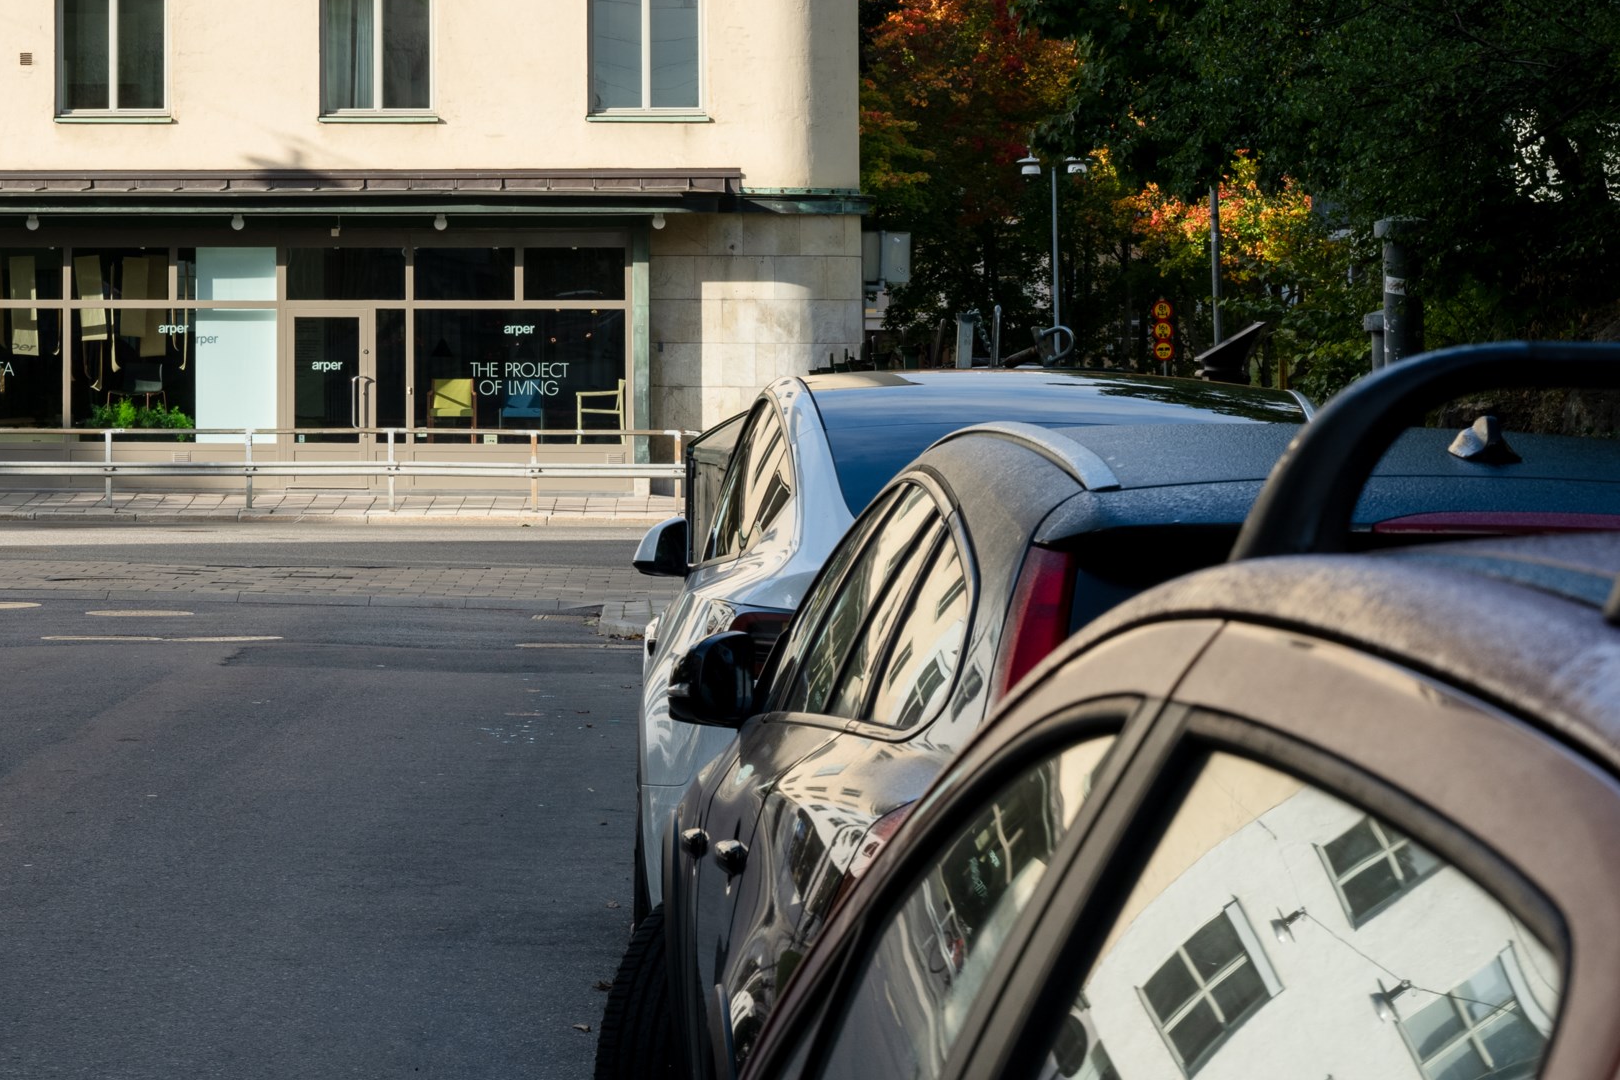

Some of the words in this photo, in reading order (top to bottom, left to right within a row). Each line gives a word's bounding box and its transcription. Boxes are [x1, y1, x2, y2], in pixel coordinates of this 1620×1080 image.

[157, 324, 189, 336] arper
[503, 324, 535, 336] arper
[311, 360, 343, 372] arper
[470, 362, 499, 377] THE
[505, 362, 570, 378] PROJECT
[479, 380, 503, 396] OF
[508, 380, 560, 396] LIVING
